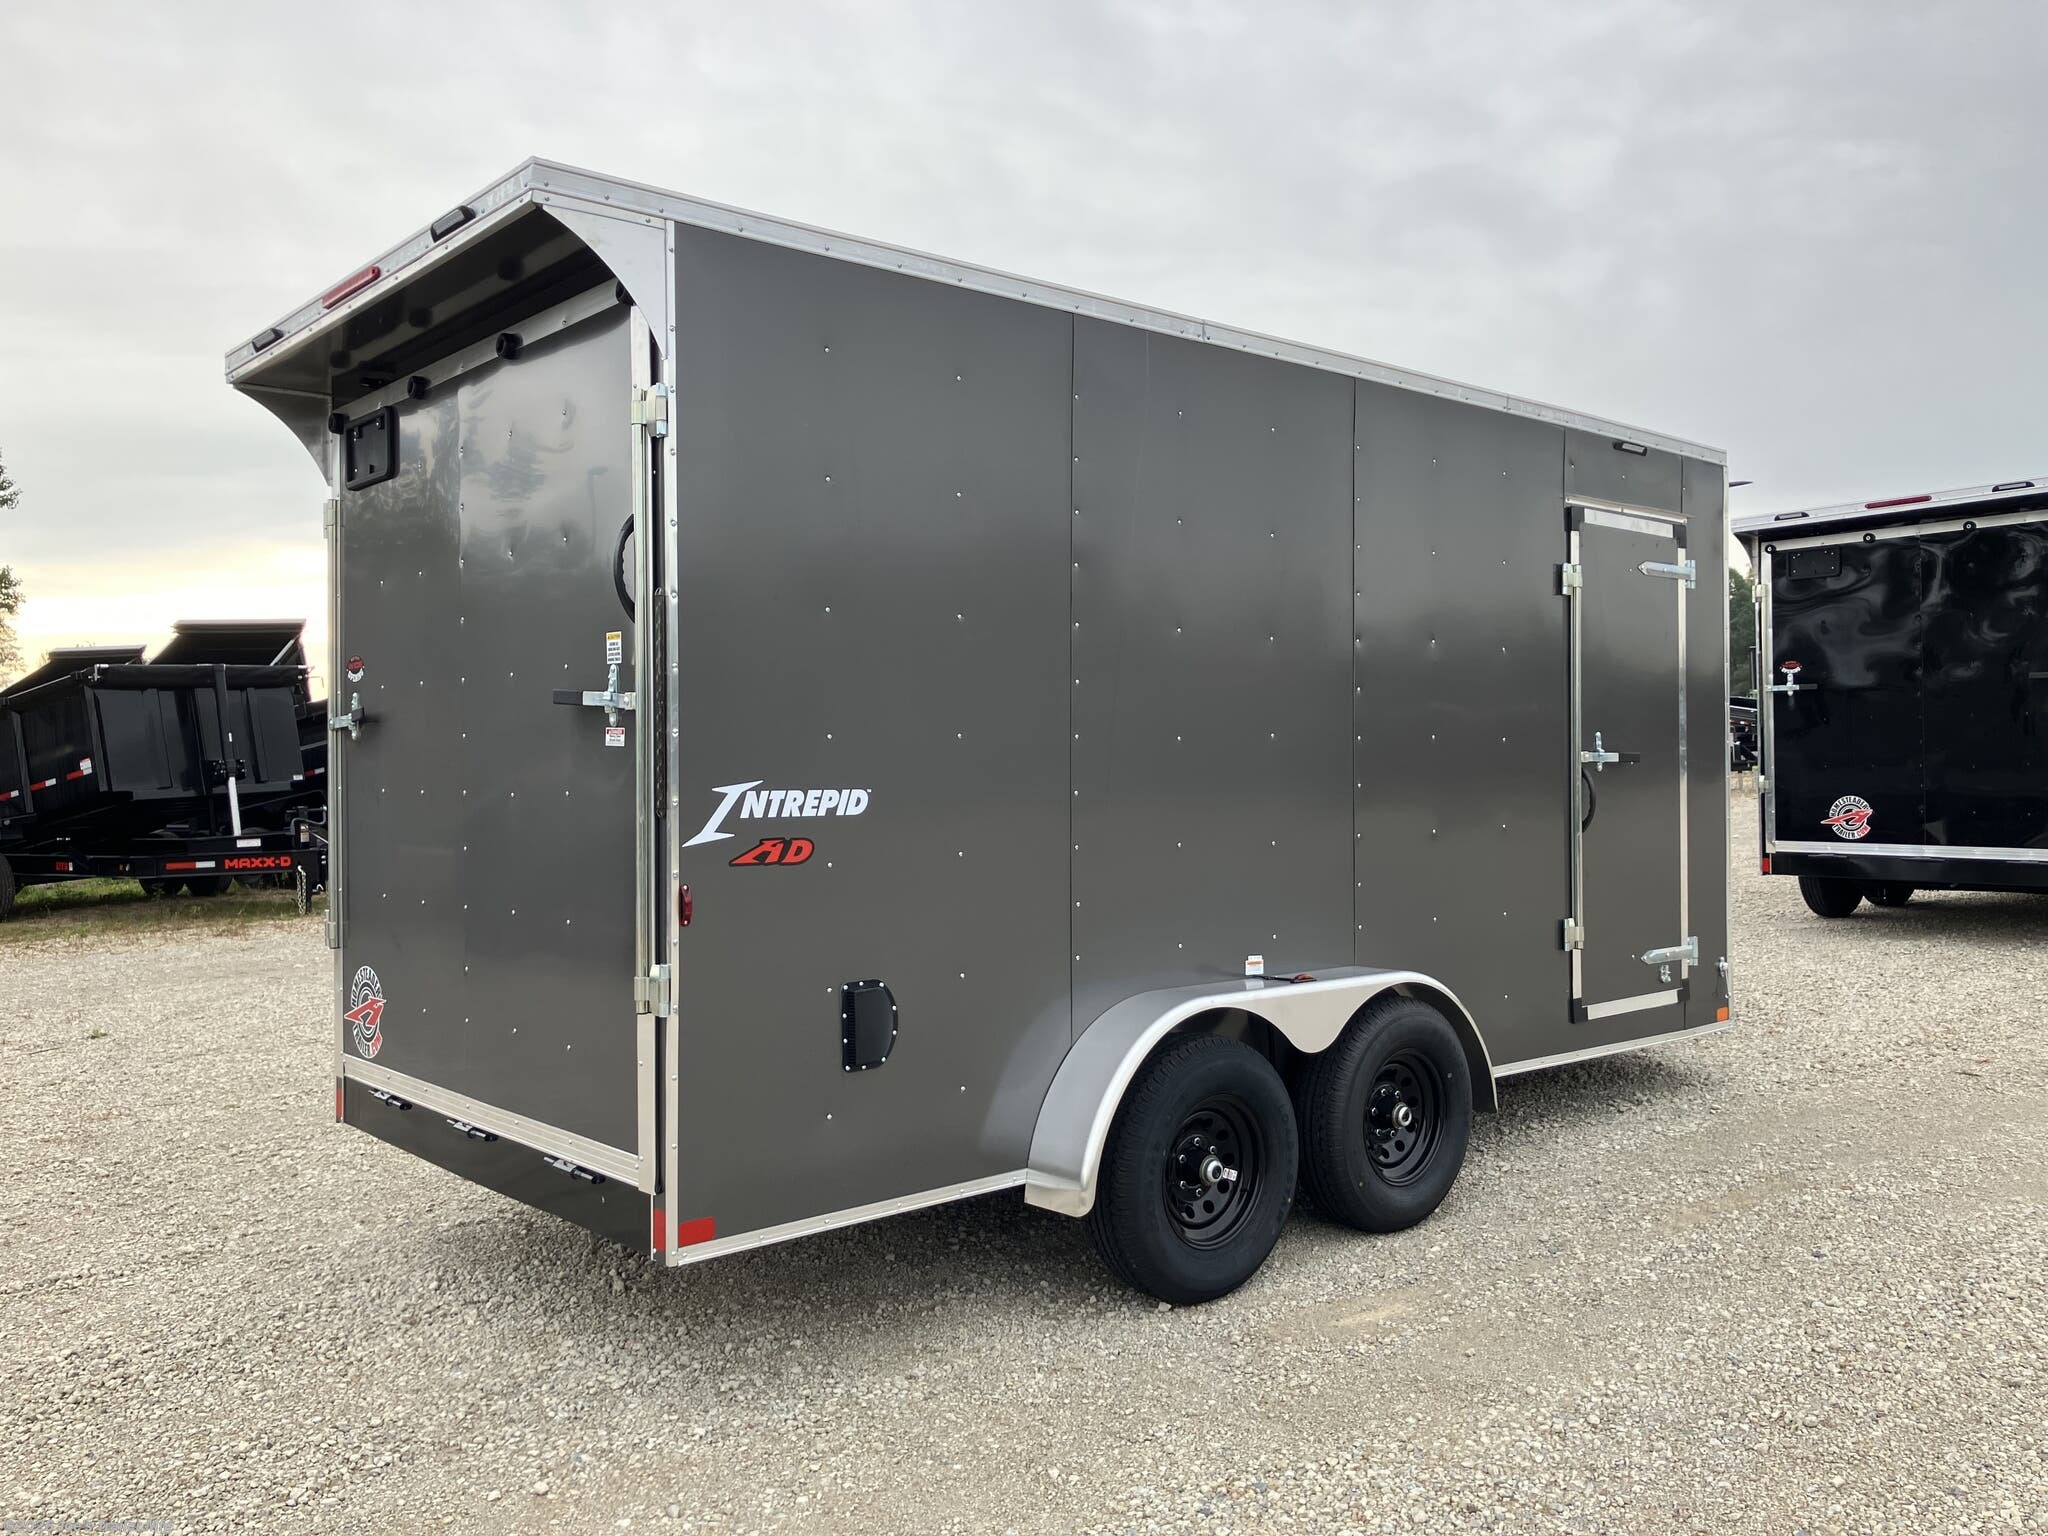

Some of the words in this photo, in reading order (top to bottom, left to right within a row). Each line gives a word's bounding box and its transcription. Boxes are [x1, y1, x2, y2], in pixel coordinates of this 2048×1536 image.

[681, 779, 869, 848] INTREPID
[224, 856, 292, 870] MAXX-D
[729, 837, 815, 867] AD
